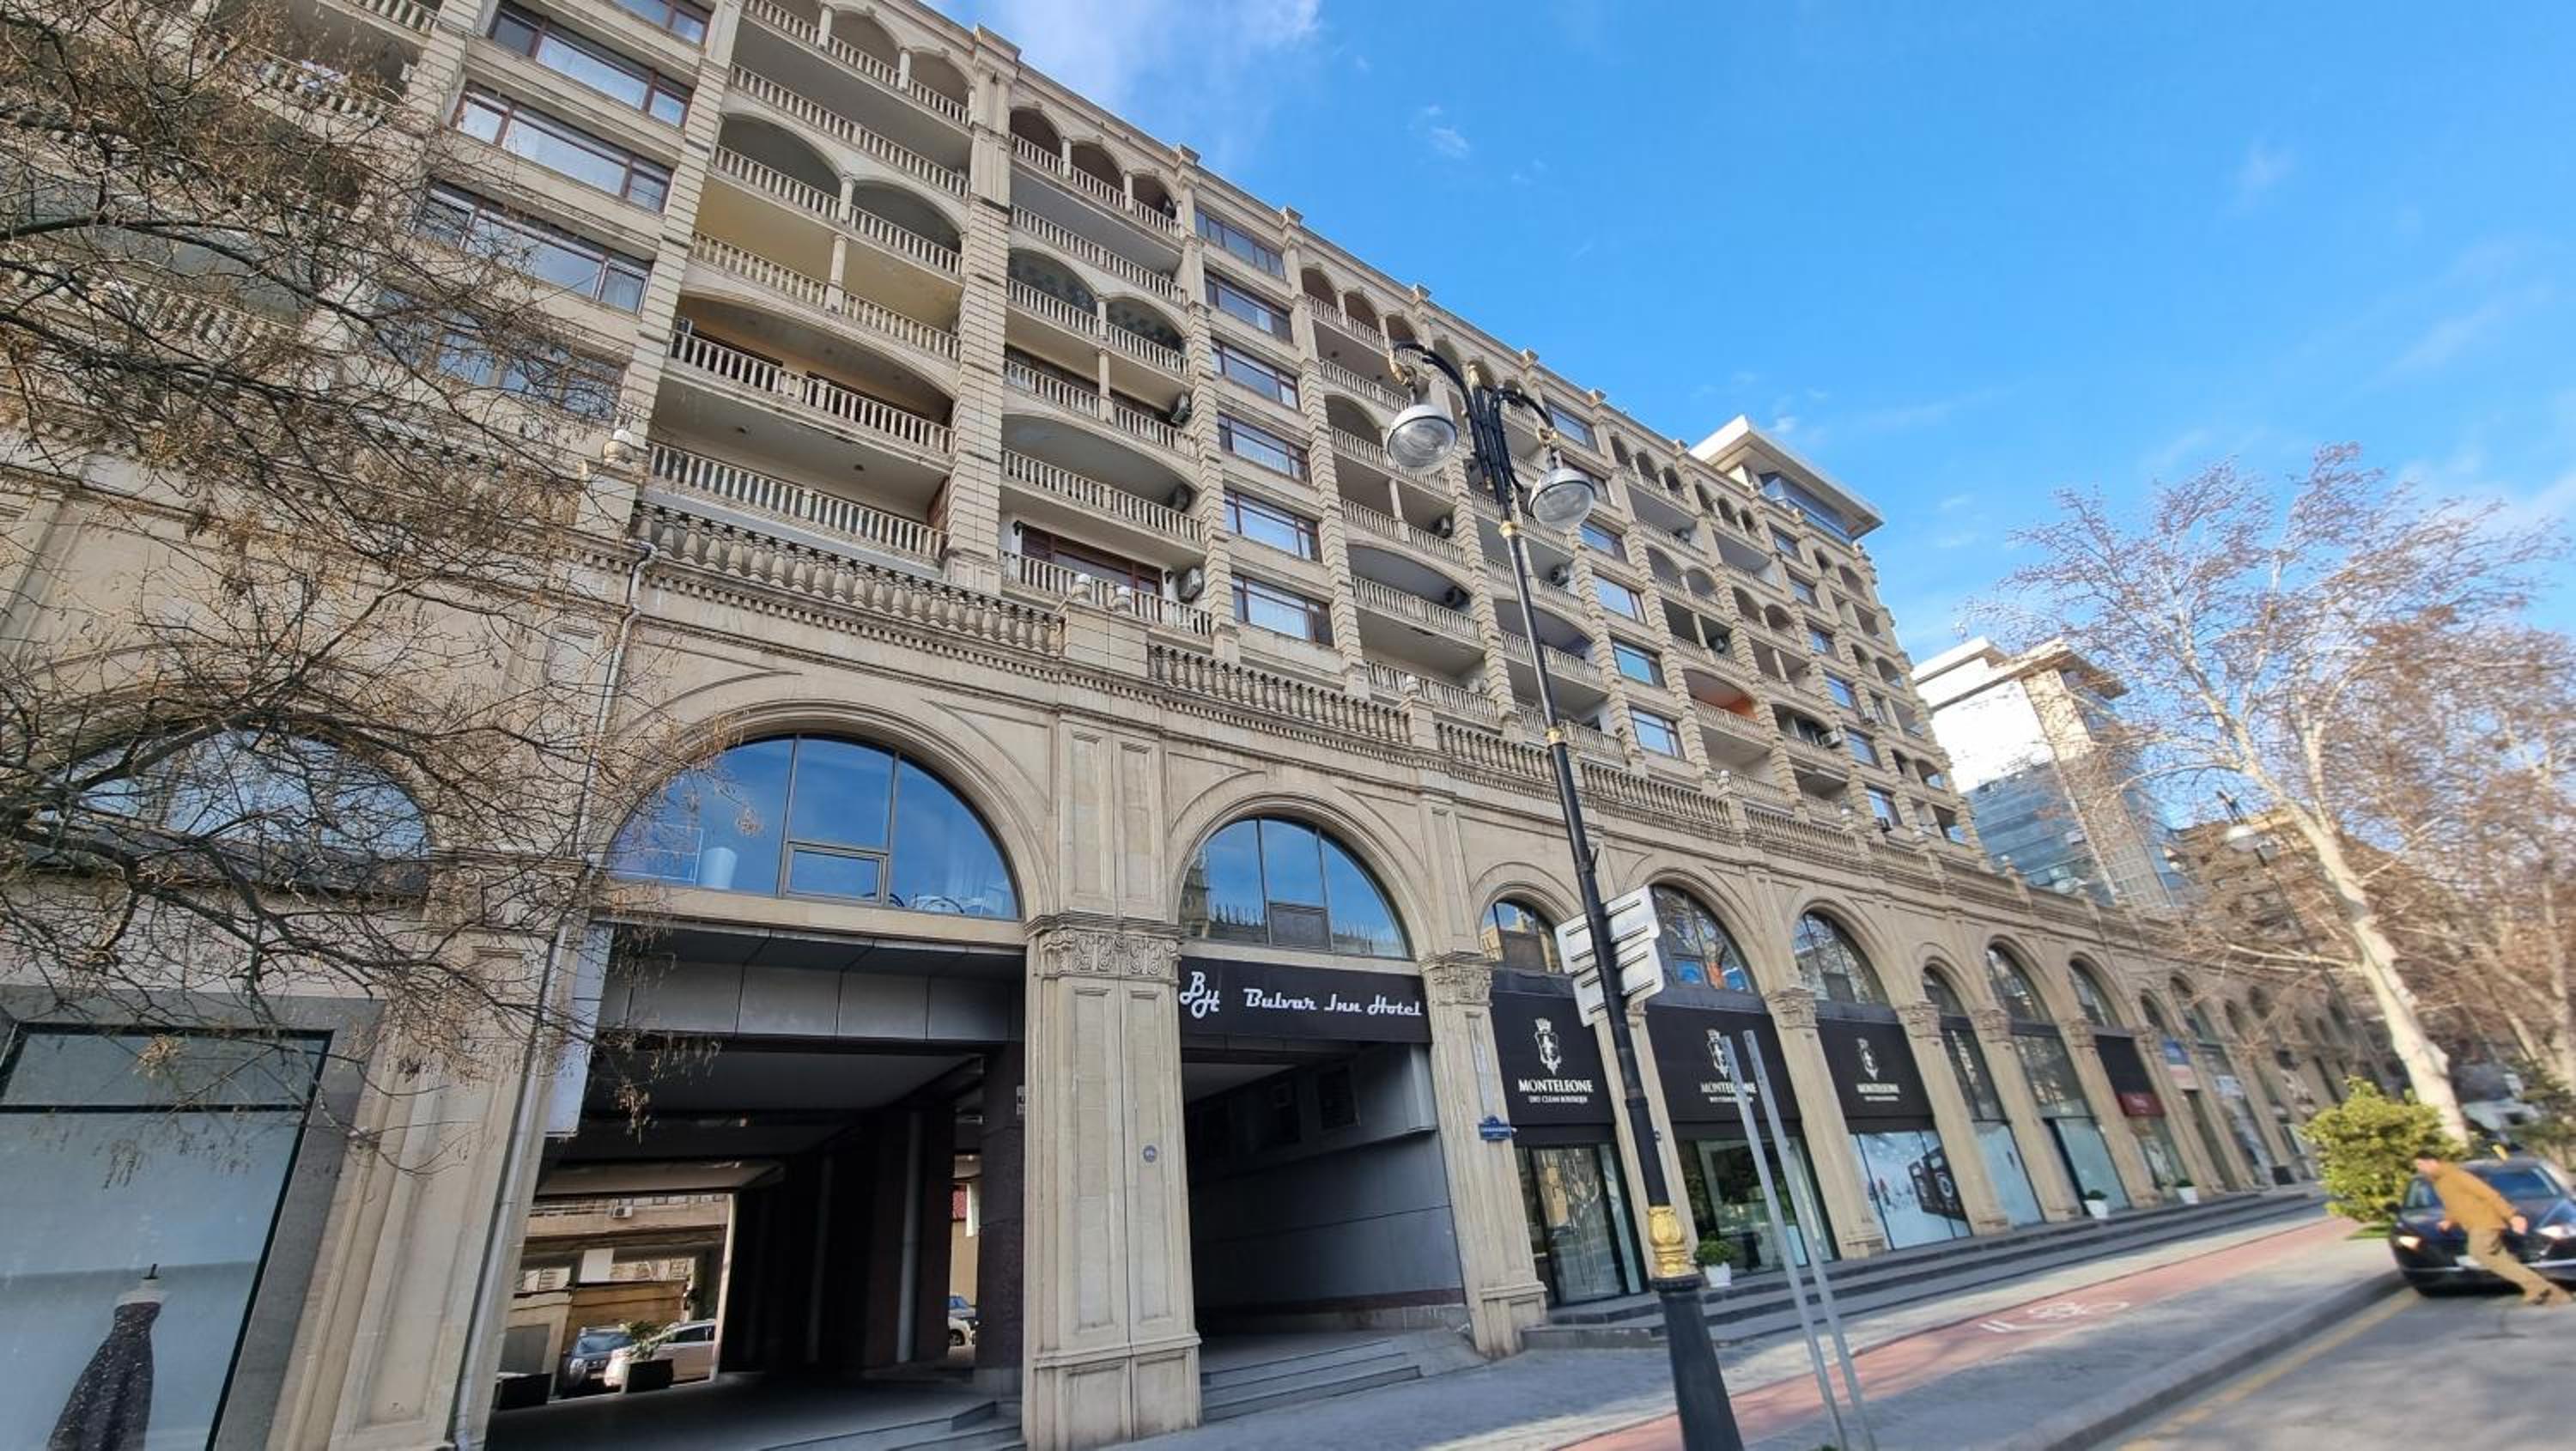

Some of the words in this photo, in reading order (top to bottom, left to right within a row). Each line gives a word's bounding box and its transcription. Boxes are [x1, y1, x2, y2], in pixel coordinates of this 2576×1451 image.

[1243, 988, 1317, 1011] Bulvar
[1324, 993, 1363, 1013] Inn
[1367, 994, 1422, 1017] Hotel
[1518, 1079, 1594, 1092] MONTELEONE
